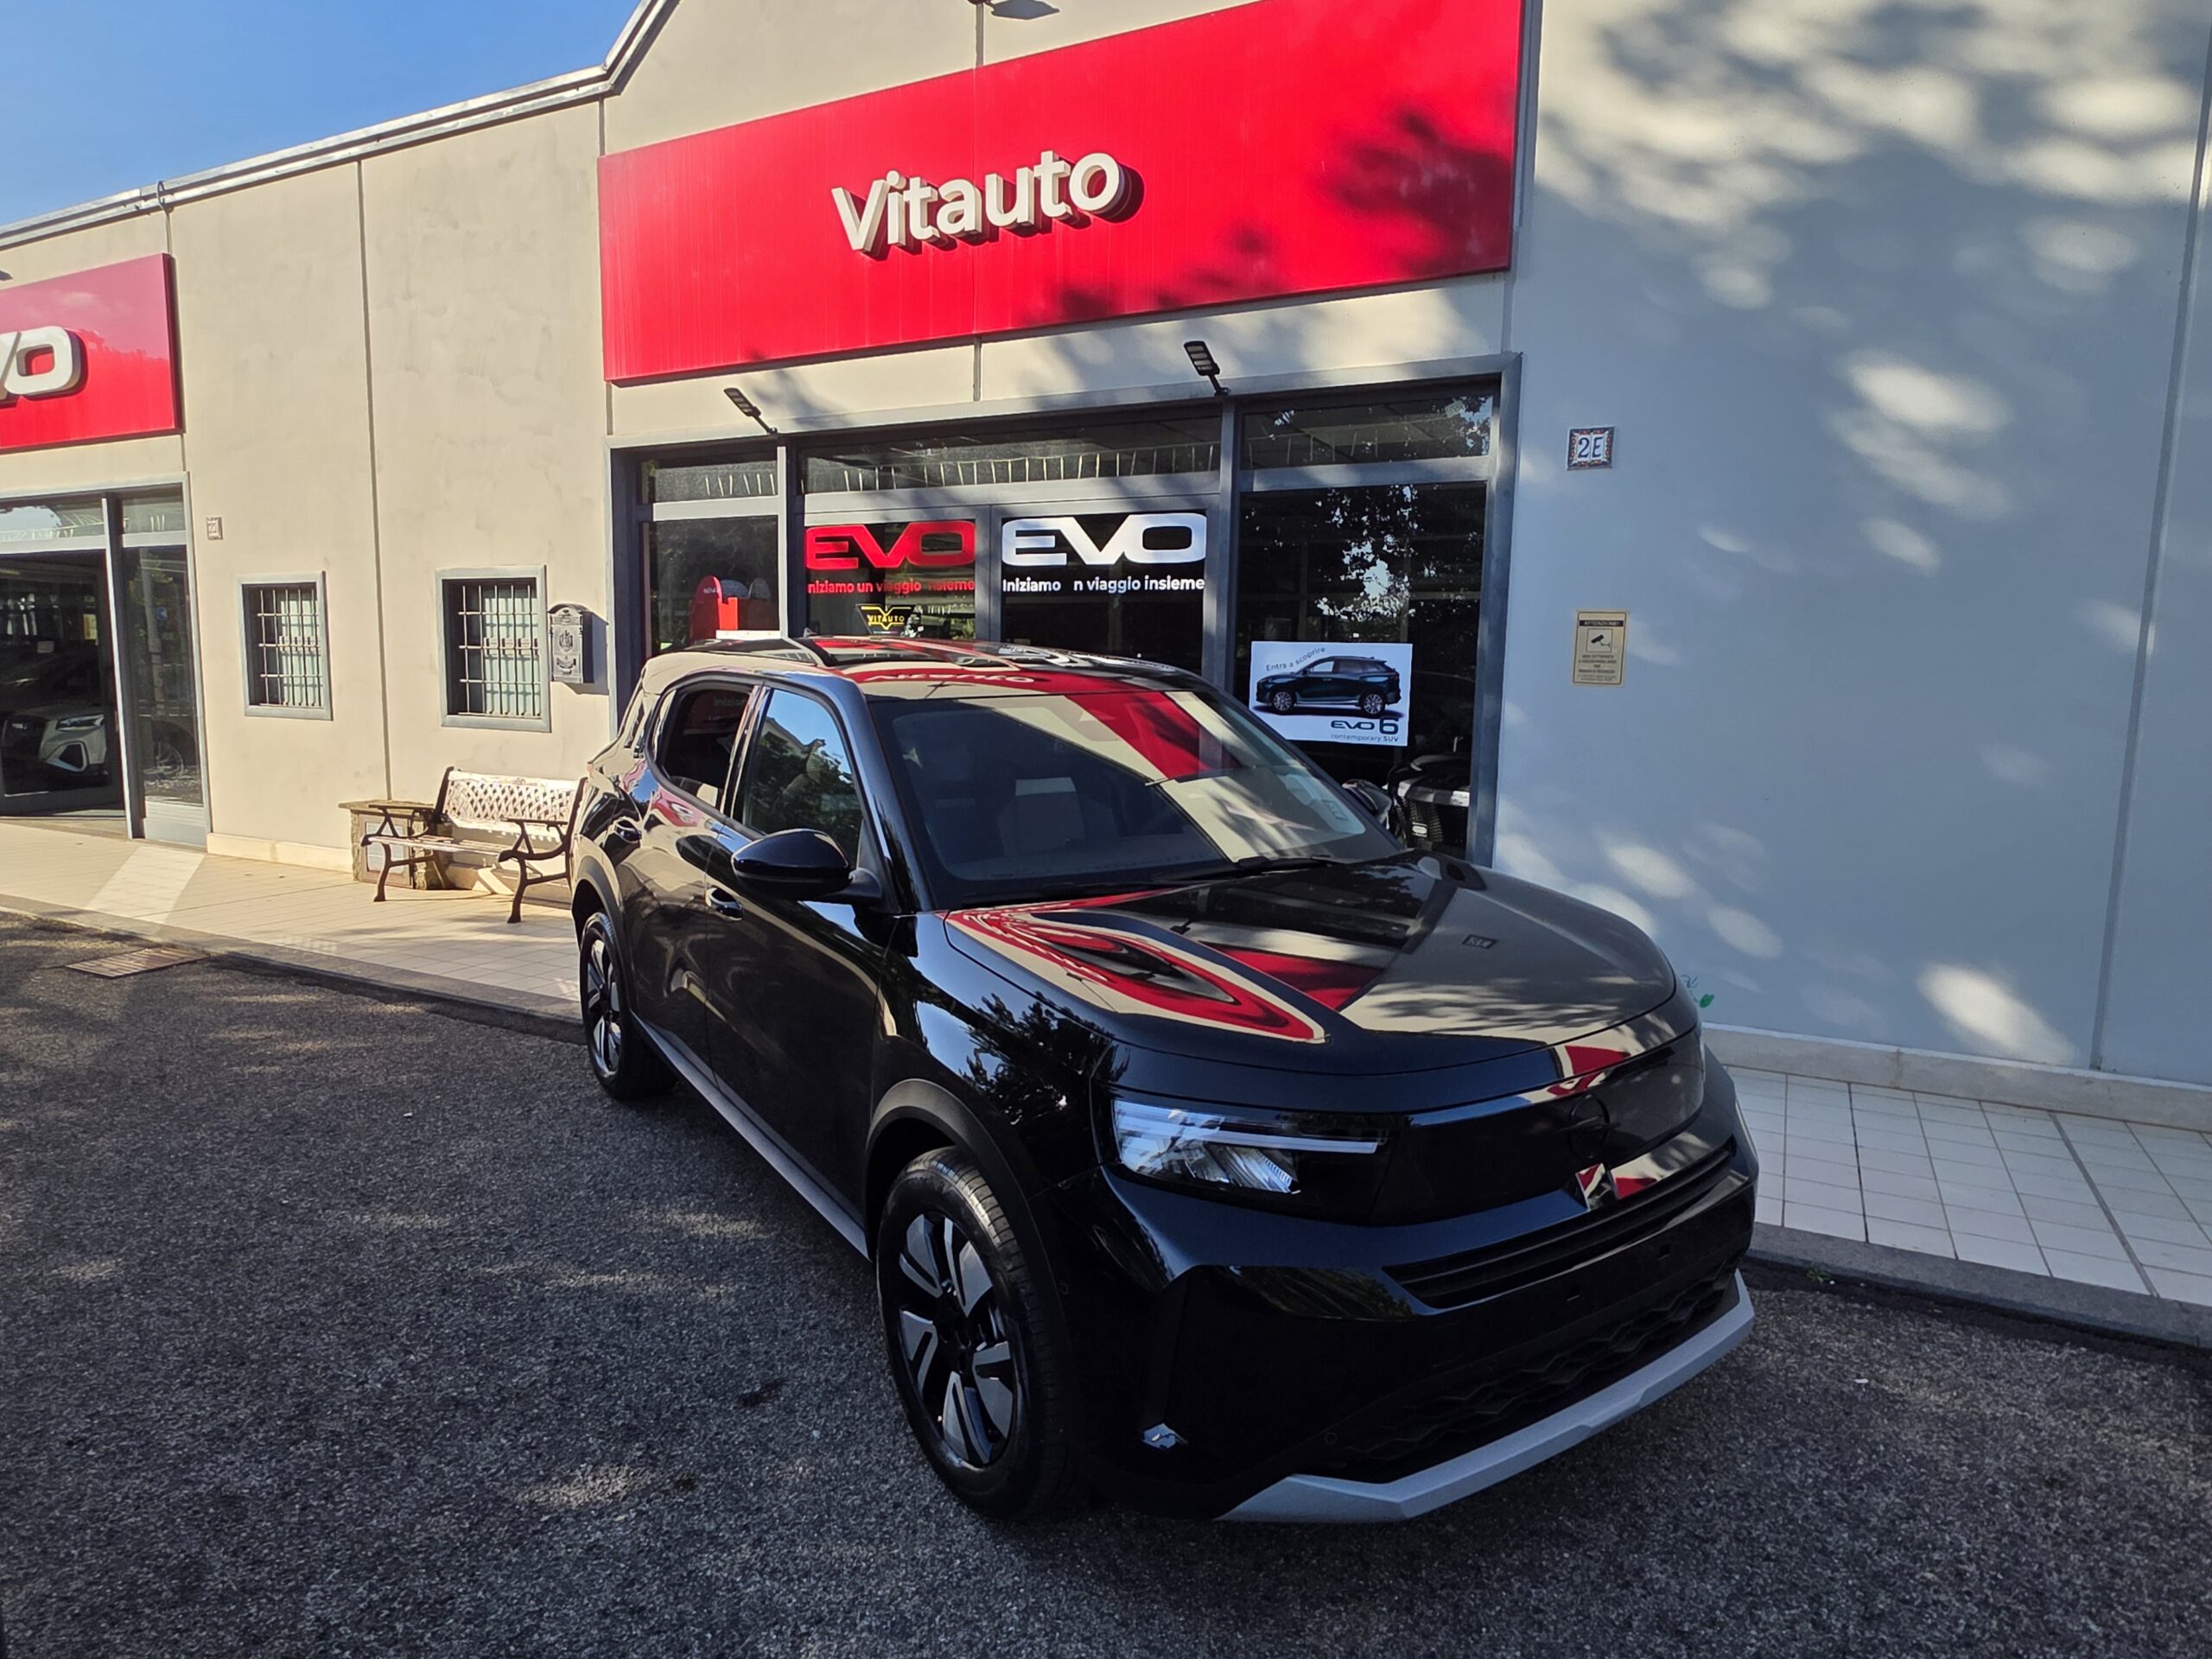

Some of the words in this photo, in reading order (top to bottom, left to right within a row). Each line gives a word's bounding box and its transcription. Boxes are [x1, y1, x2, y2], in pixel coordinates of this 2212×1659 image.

[831, 150, 1122, 251] Vitauto
[1578, 437, 1604, 458] 2E
[806, 521, 976, 569] EVO
[1002, 512, 1207, 566] EVO
[808, 581, 854, 594] niziamo
[857, 582, 873, 593] un
[876, 578, 922, 594] viaggio
[927, 579, 976, 591] nsieme
[1002, 576, 1061, 593] Iniziamo
[1086, 575, 1141, 594] viaggio
[1144, 575, 1205, 590] insieme
[1266, 662, 1287, 671] Entra
[1295, 647, 1325, 665] scoprire
[1331, 720, 1375, 730] EVO
[1379, 717, 1399, 735] 6
[1331, 734, 1382, 742] contemporary
